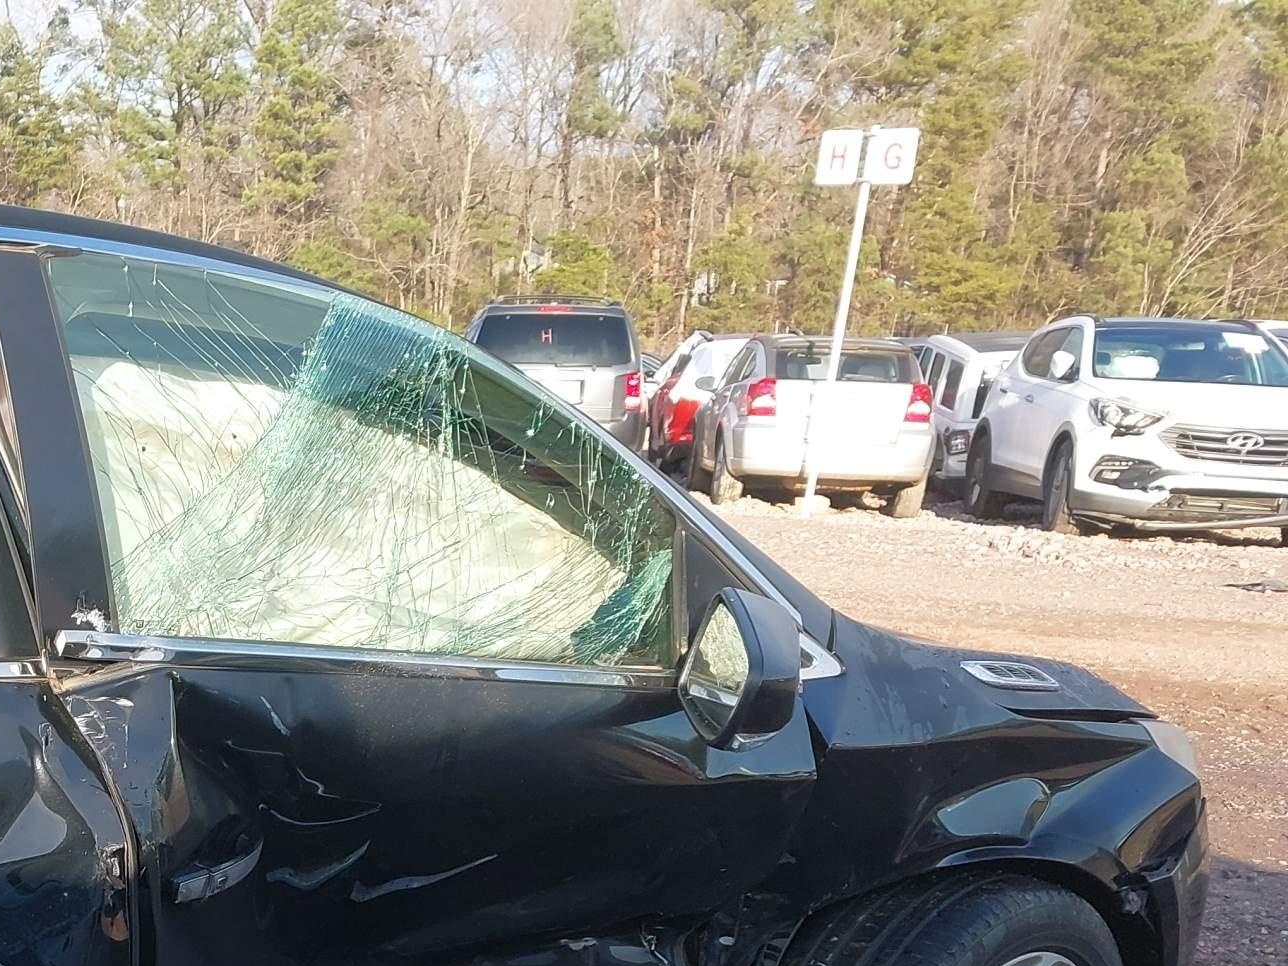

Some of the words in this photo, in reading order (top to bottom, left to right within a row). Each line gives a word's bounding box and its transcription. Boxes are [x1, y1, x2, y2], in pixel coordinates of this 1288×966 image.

[830, 144, 847, 169] H
[884, 143, 903, 169] G
[541, 328, 553, 344] H
